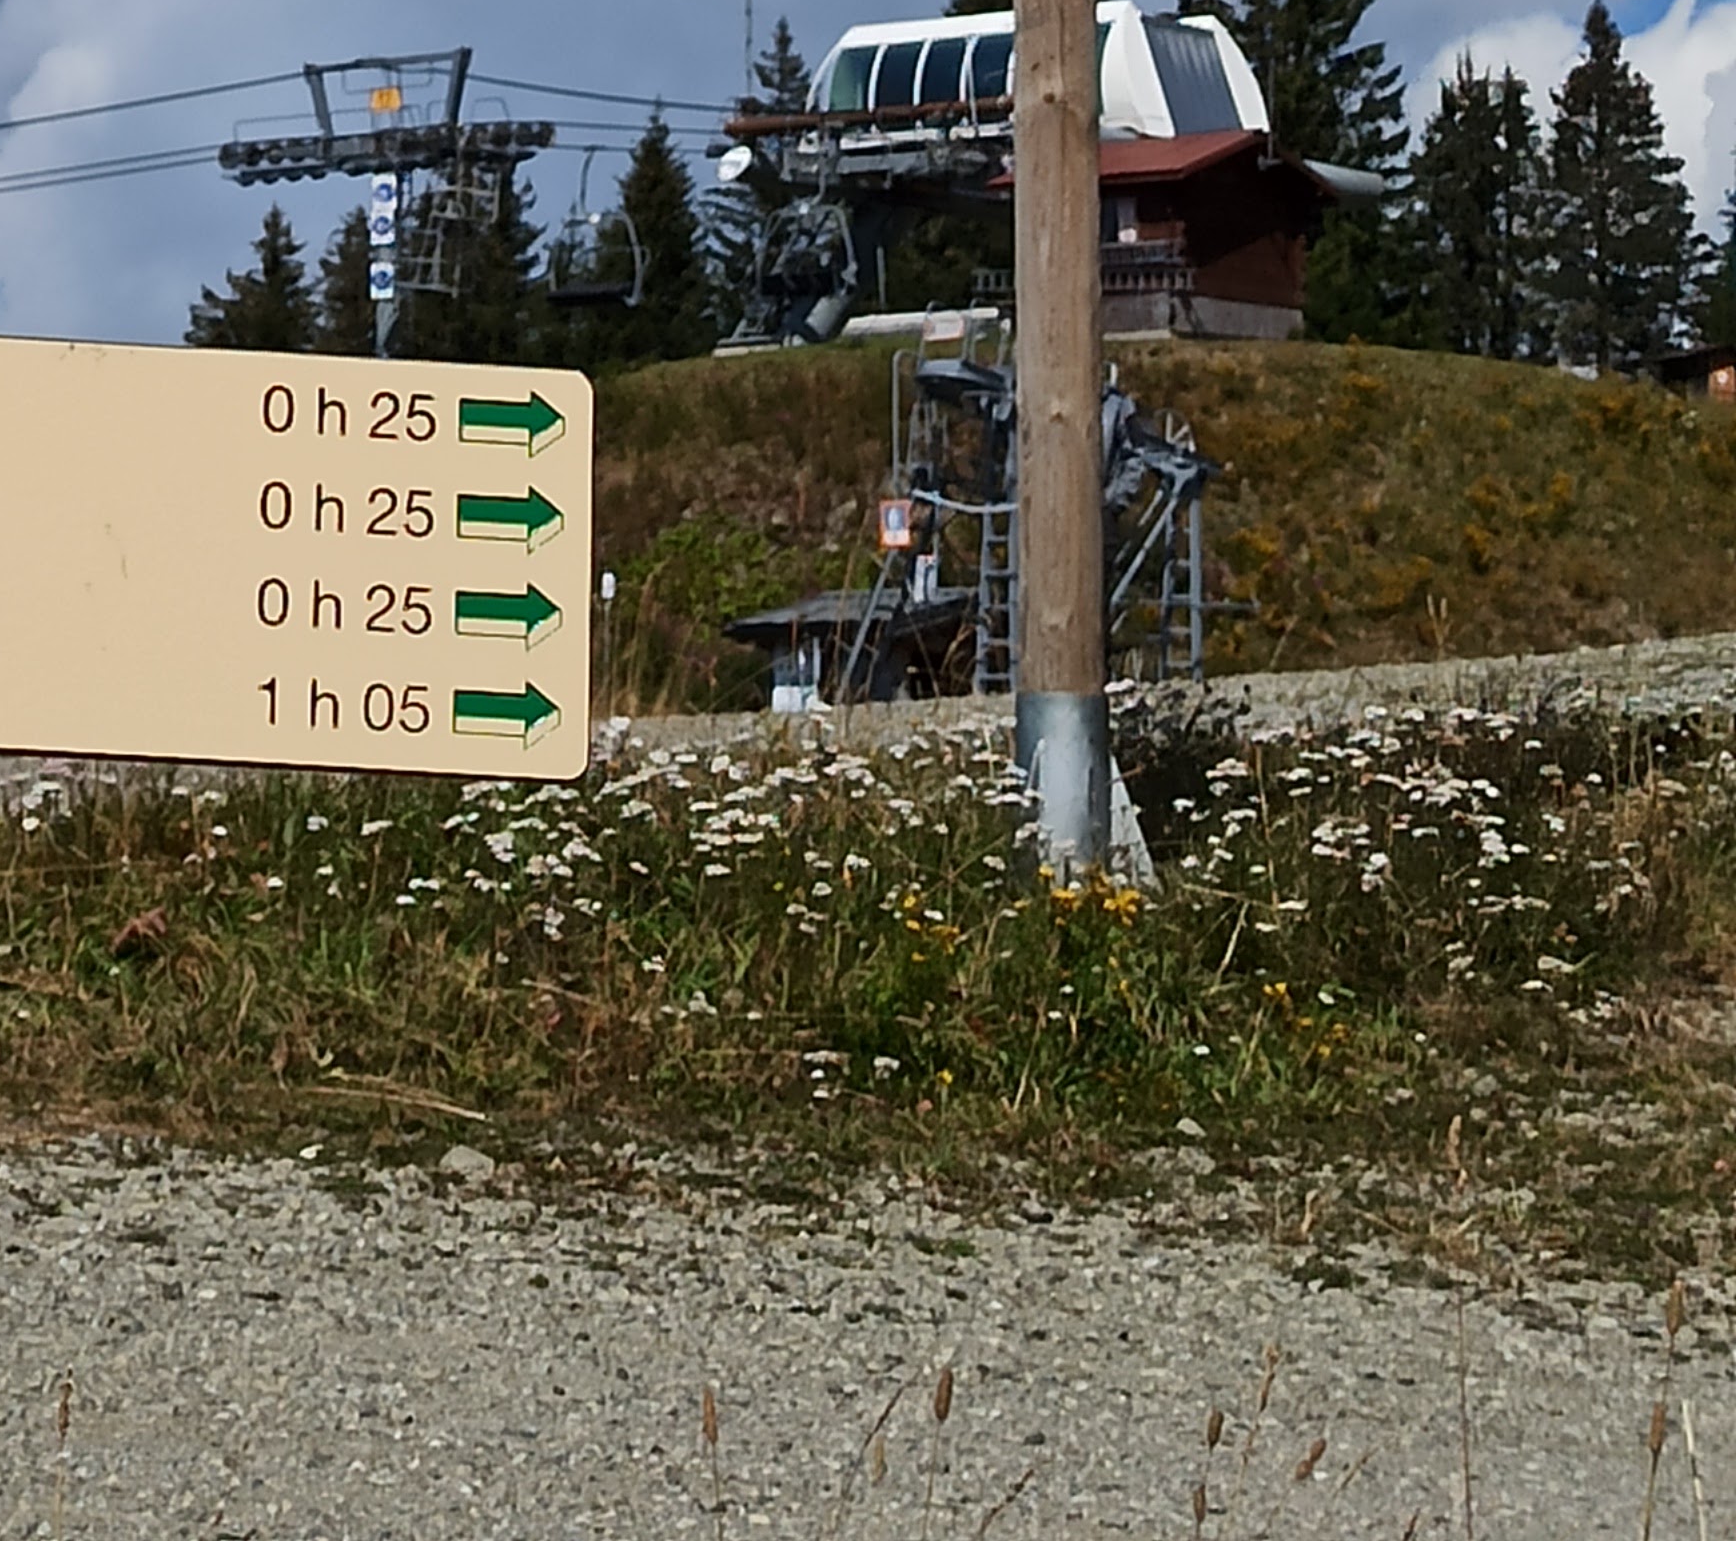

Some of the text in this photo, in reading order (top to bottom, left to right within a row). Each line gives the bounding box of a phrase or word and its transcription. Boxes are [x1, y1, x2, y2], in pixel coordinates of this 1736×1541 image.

[263, 385, 436, 441] 0 h 25
[260, 482, 433, 537] 0 h 25
[258, 578, 431, 635] 0 h 25
[258, 677, 429, 733] 1 h 05
